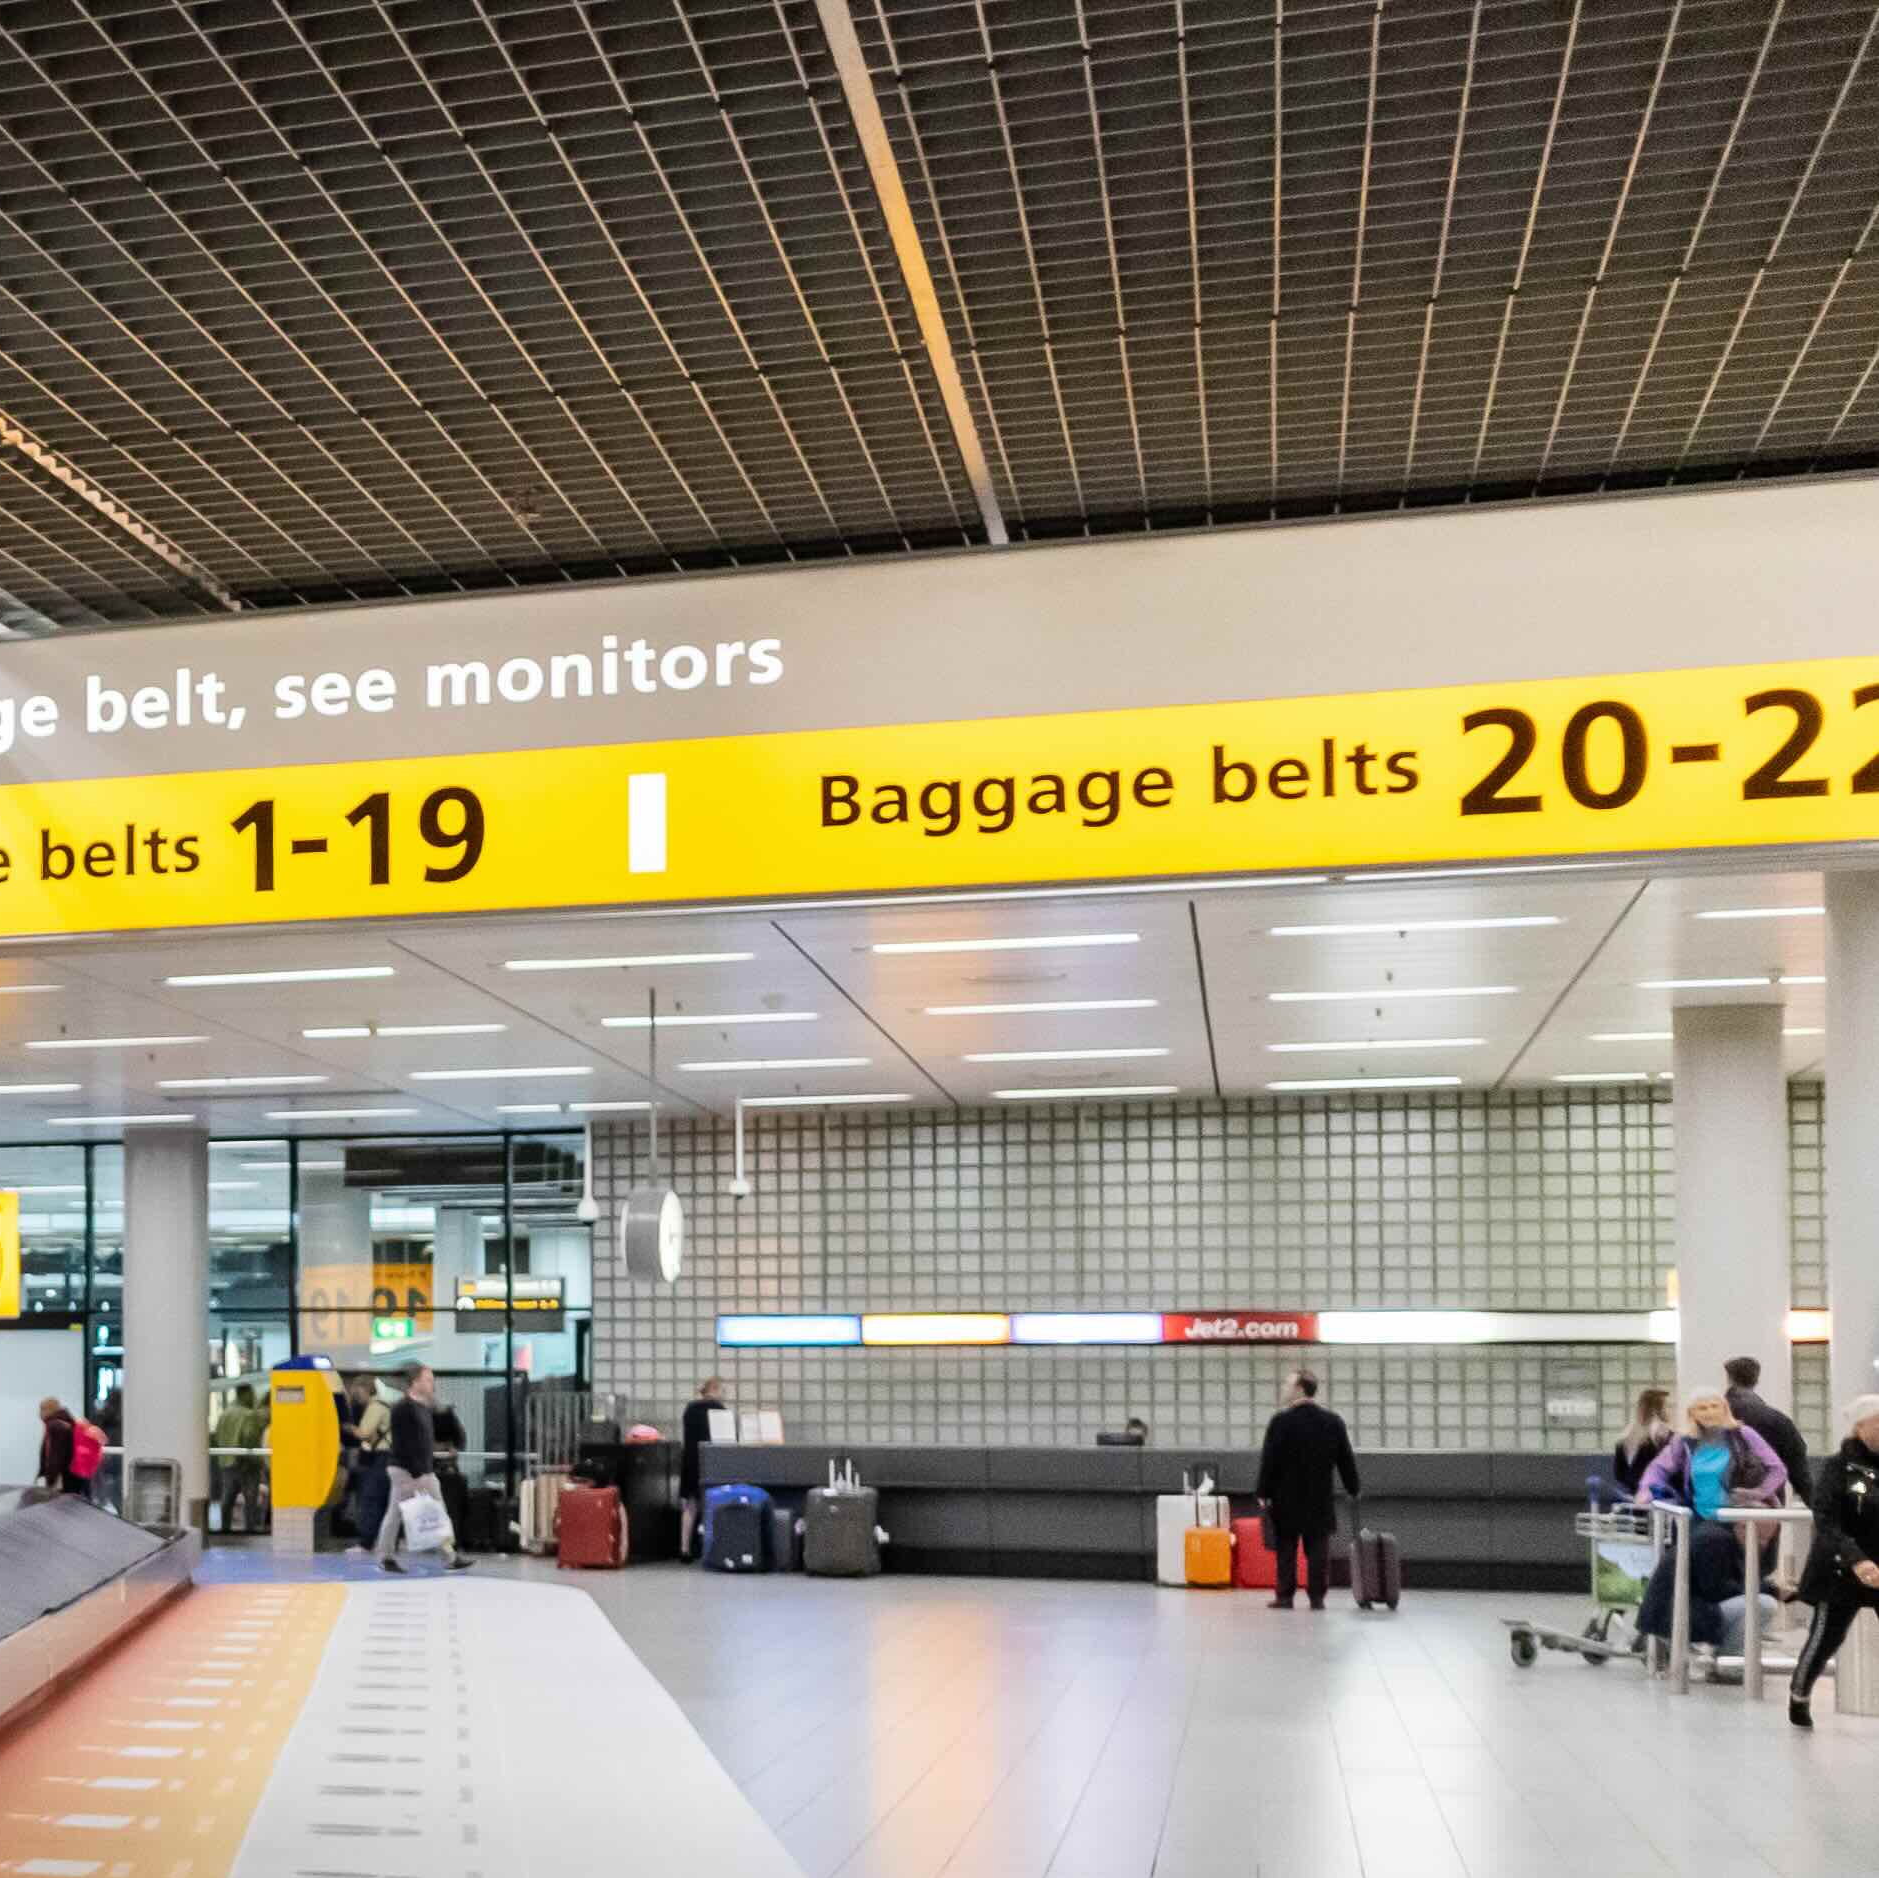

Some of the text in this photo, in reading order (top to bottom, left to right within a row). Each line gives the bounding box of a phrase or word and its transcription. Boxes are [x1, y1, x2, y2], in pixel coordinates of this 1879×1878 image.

[86, 668, 246, 732] belt,
[274, 667, 397, 719] see
[426, 635, 784, 708] monitors
[819, 764, 1175, 838] Baggage
[1211, 739, 1421, 805] belts
[39, 822, 201, 882] belts
[230, 785, 486, 893] 1-19
